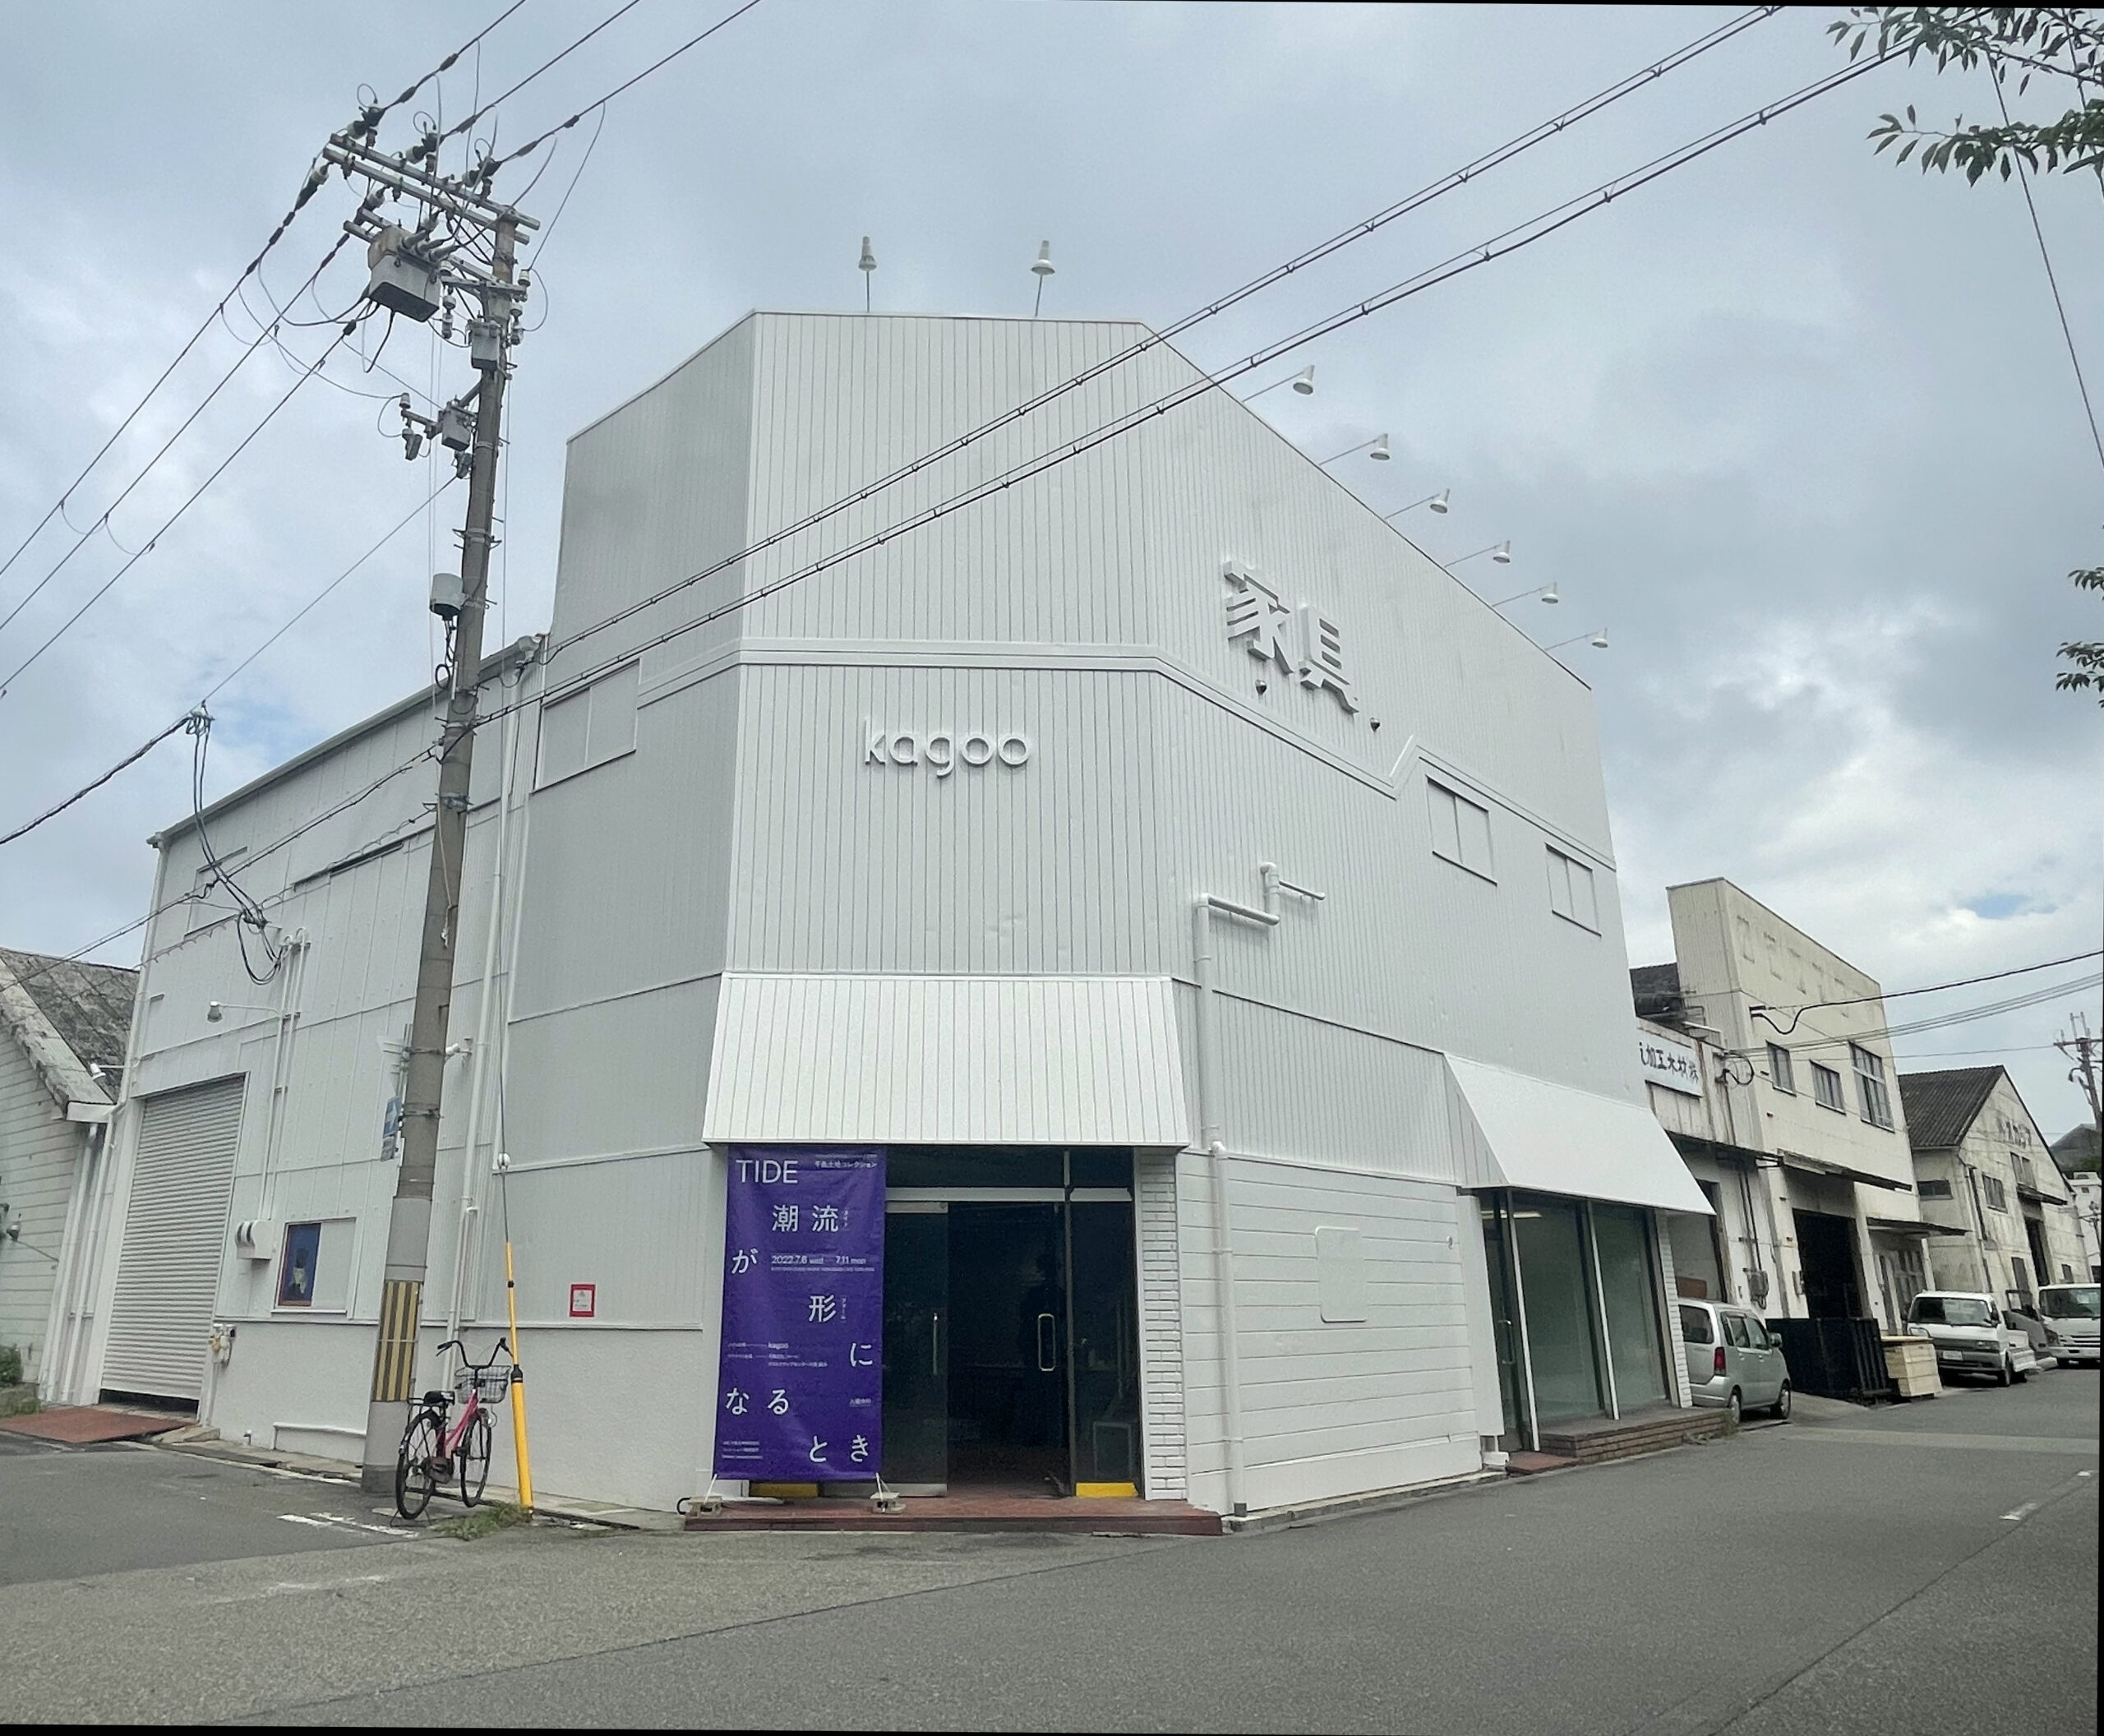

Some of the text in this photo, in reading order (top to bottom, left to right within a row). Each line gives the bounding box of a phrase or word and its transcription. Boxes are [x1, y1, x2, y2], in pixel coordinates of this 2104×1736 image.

[1220, 559, 1360, 715] 家具
[864, 717, 1031, 779] kagoo
[736, 1159, 799, 1184] TIDE
[772, 1204, 839, 1233] 潮流
[731, 1248, 759, 1274] が
[808, 1294, 837, 1323] 形
[850, 1342, 874, 1367] に
[725, 1387, 789, 1415] なる
[809, 1434, 869, 1463] とき
